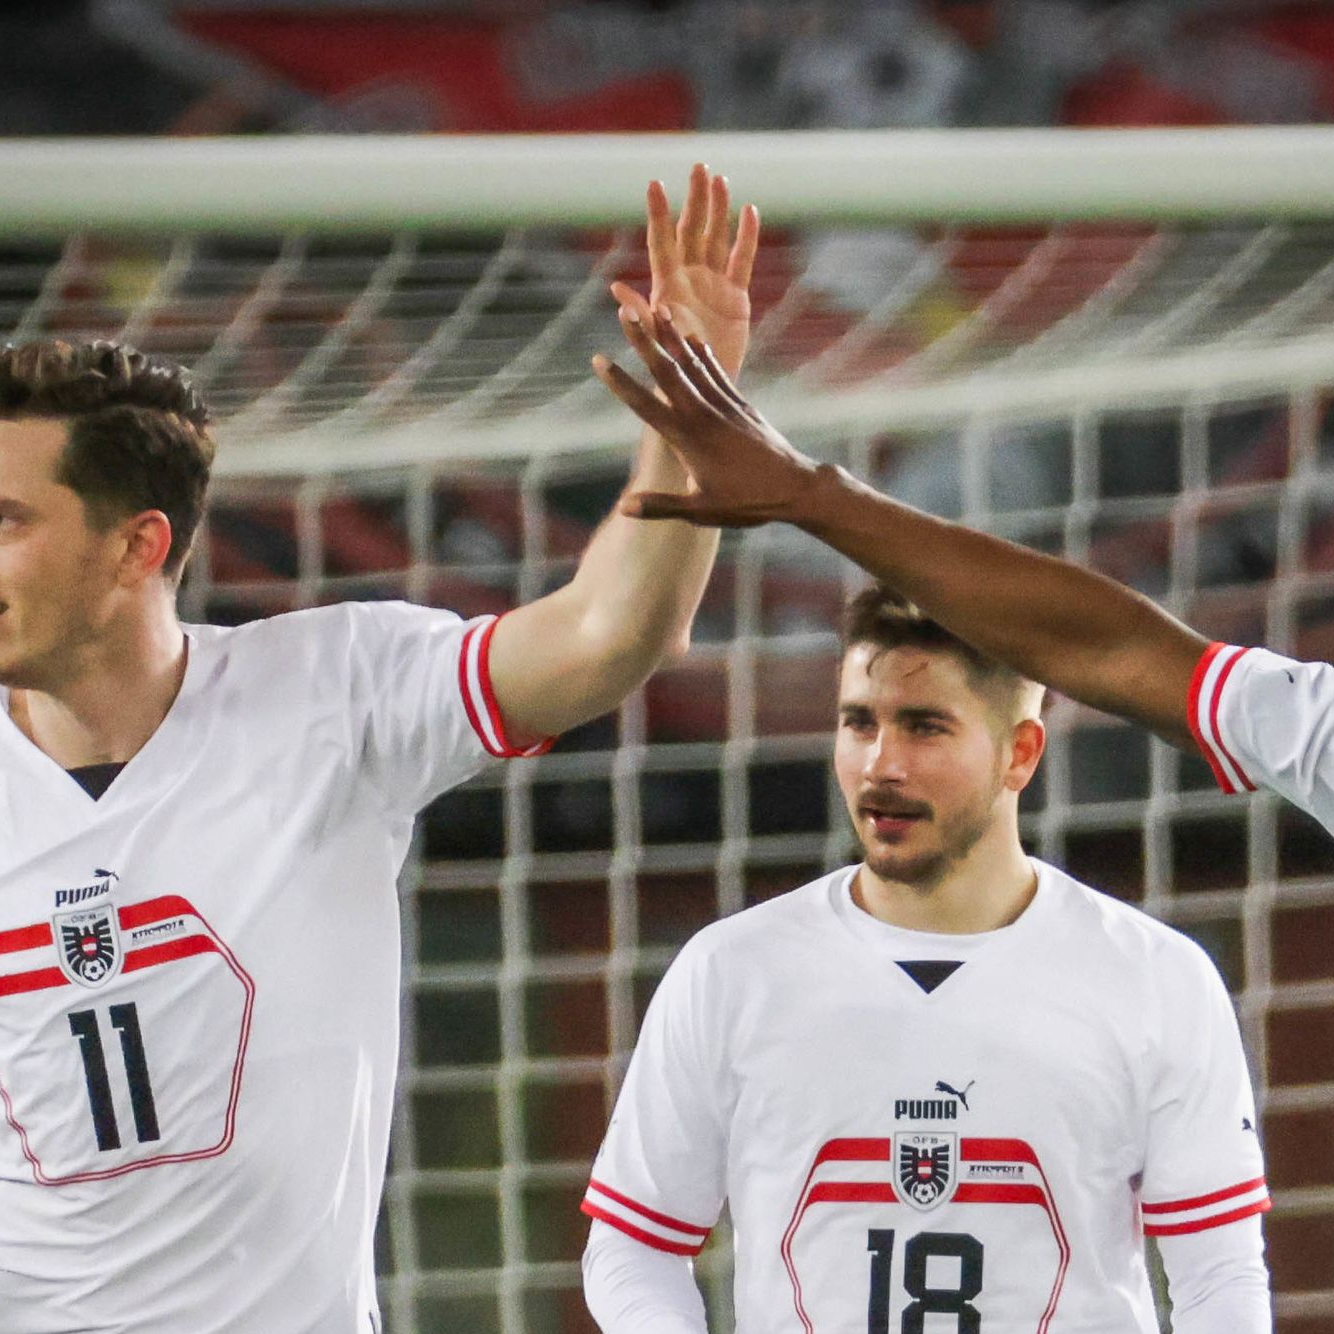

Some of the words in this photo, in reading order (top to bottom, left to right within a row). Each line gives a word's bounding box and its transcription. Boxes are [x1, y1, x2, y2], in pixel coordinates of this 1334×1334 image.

[55, 878, 110, 908] PUMA
[68, 1001, 161, 1152] 11
[894, 1099, 958, 1120] PUMA
